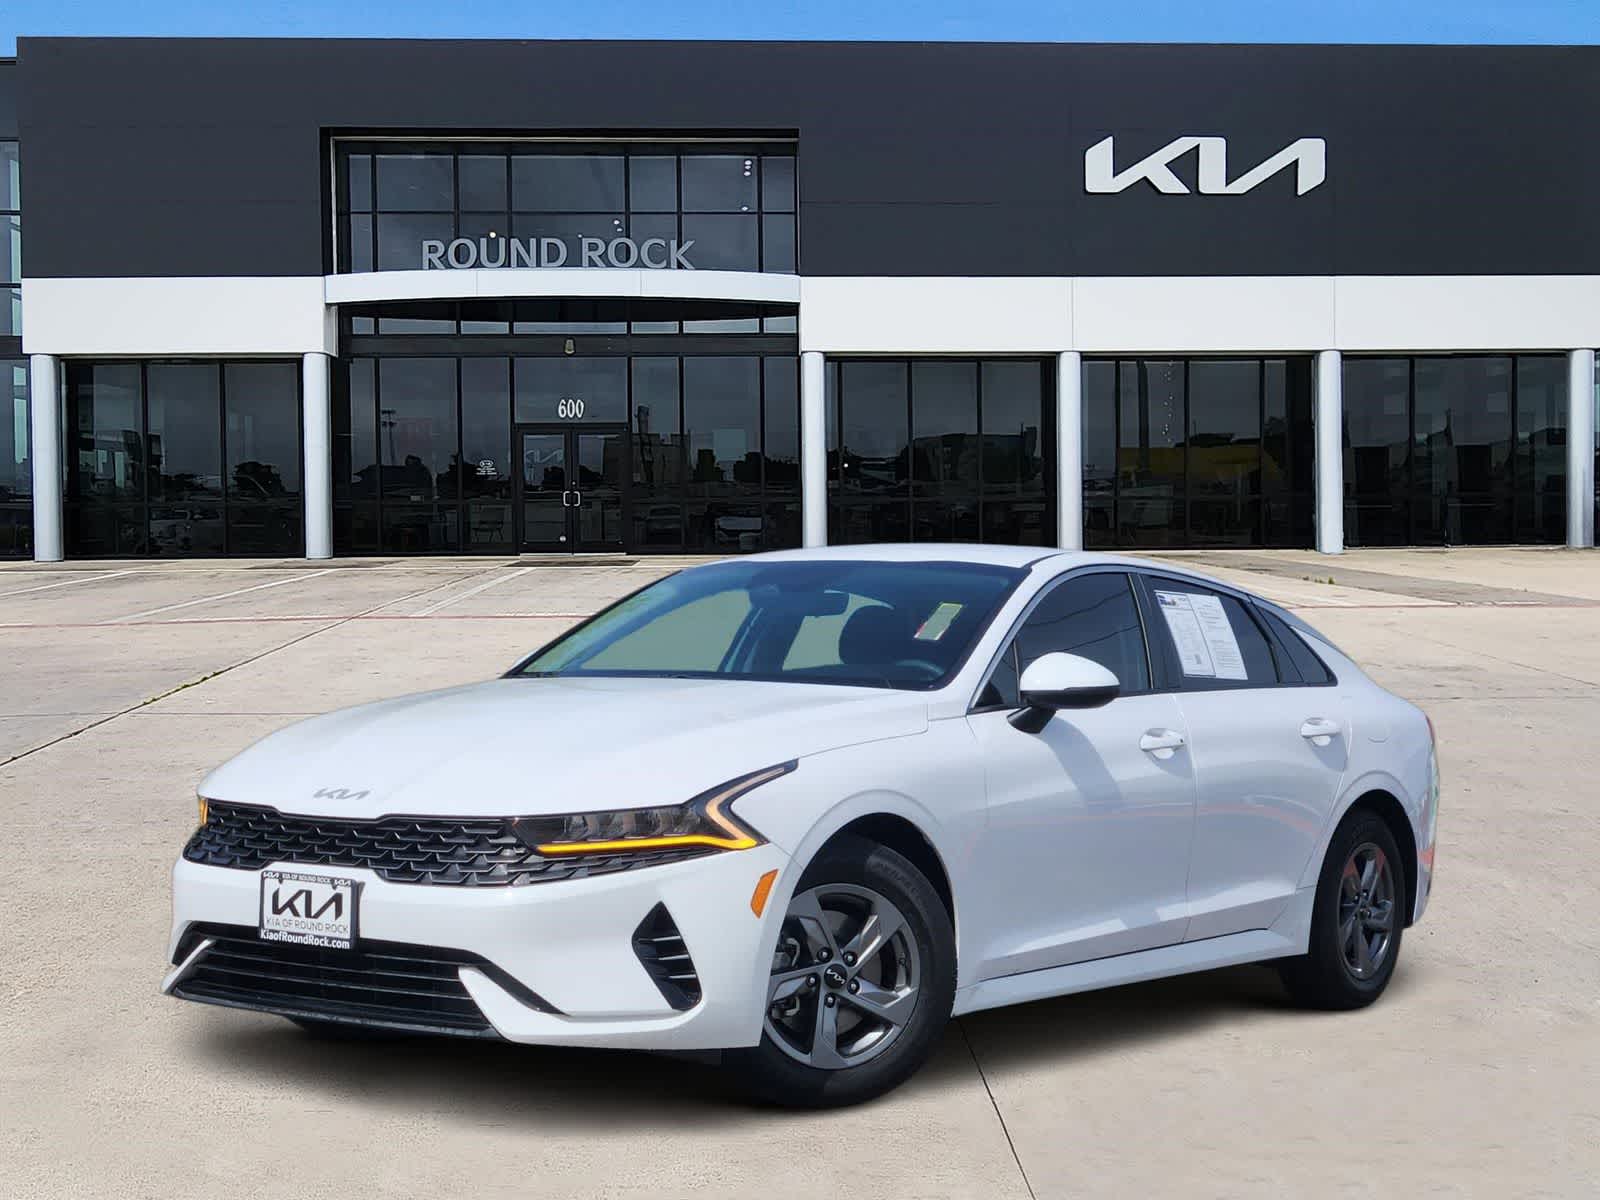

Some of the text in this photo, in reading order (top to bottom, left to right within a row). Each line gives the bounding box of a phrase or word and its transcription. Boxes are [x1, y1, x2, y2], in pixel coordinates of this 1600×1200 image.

[1084, 135, 1326, 197] KIA
[421, 237, 696, 270] ROUND ROCK
[557, 399, 585, 419] 600
[272, 887, 343, 921] KIA
[266, 915, 349, 934] KIA OF ROUND ROCK
[260, 929, 350, 949] KiaofRoundRock.com
